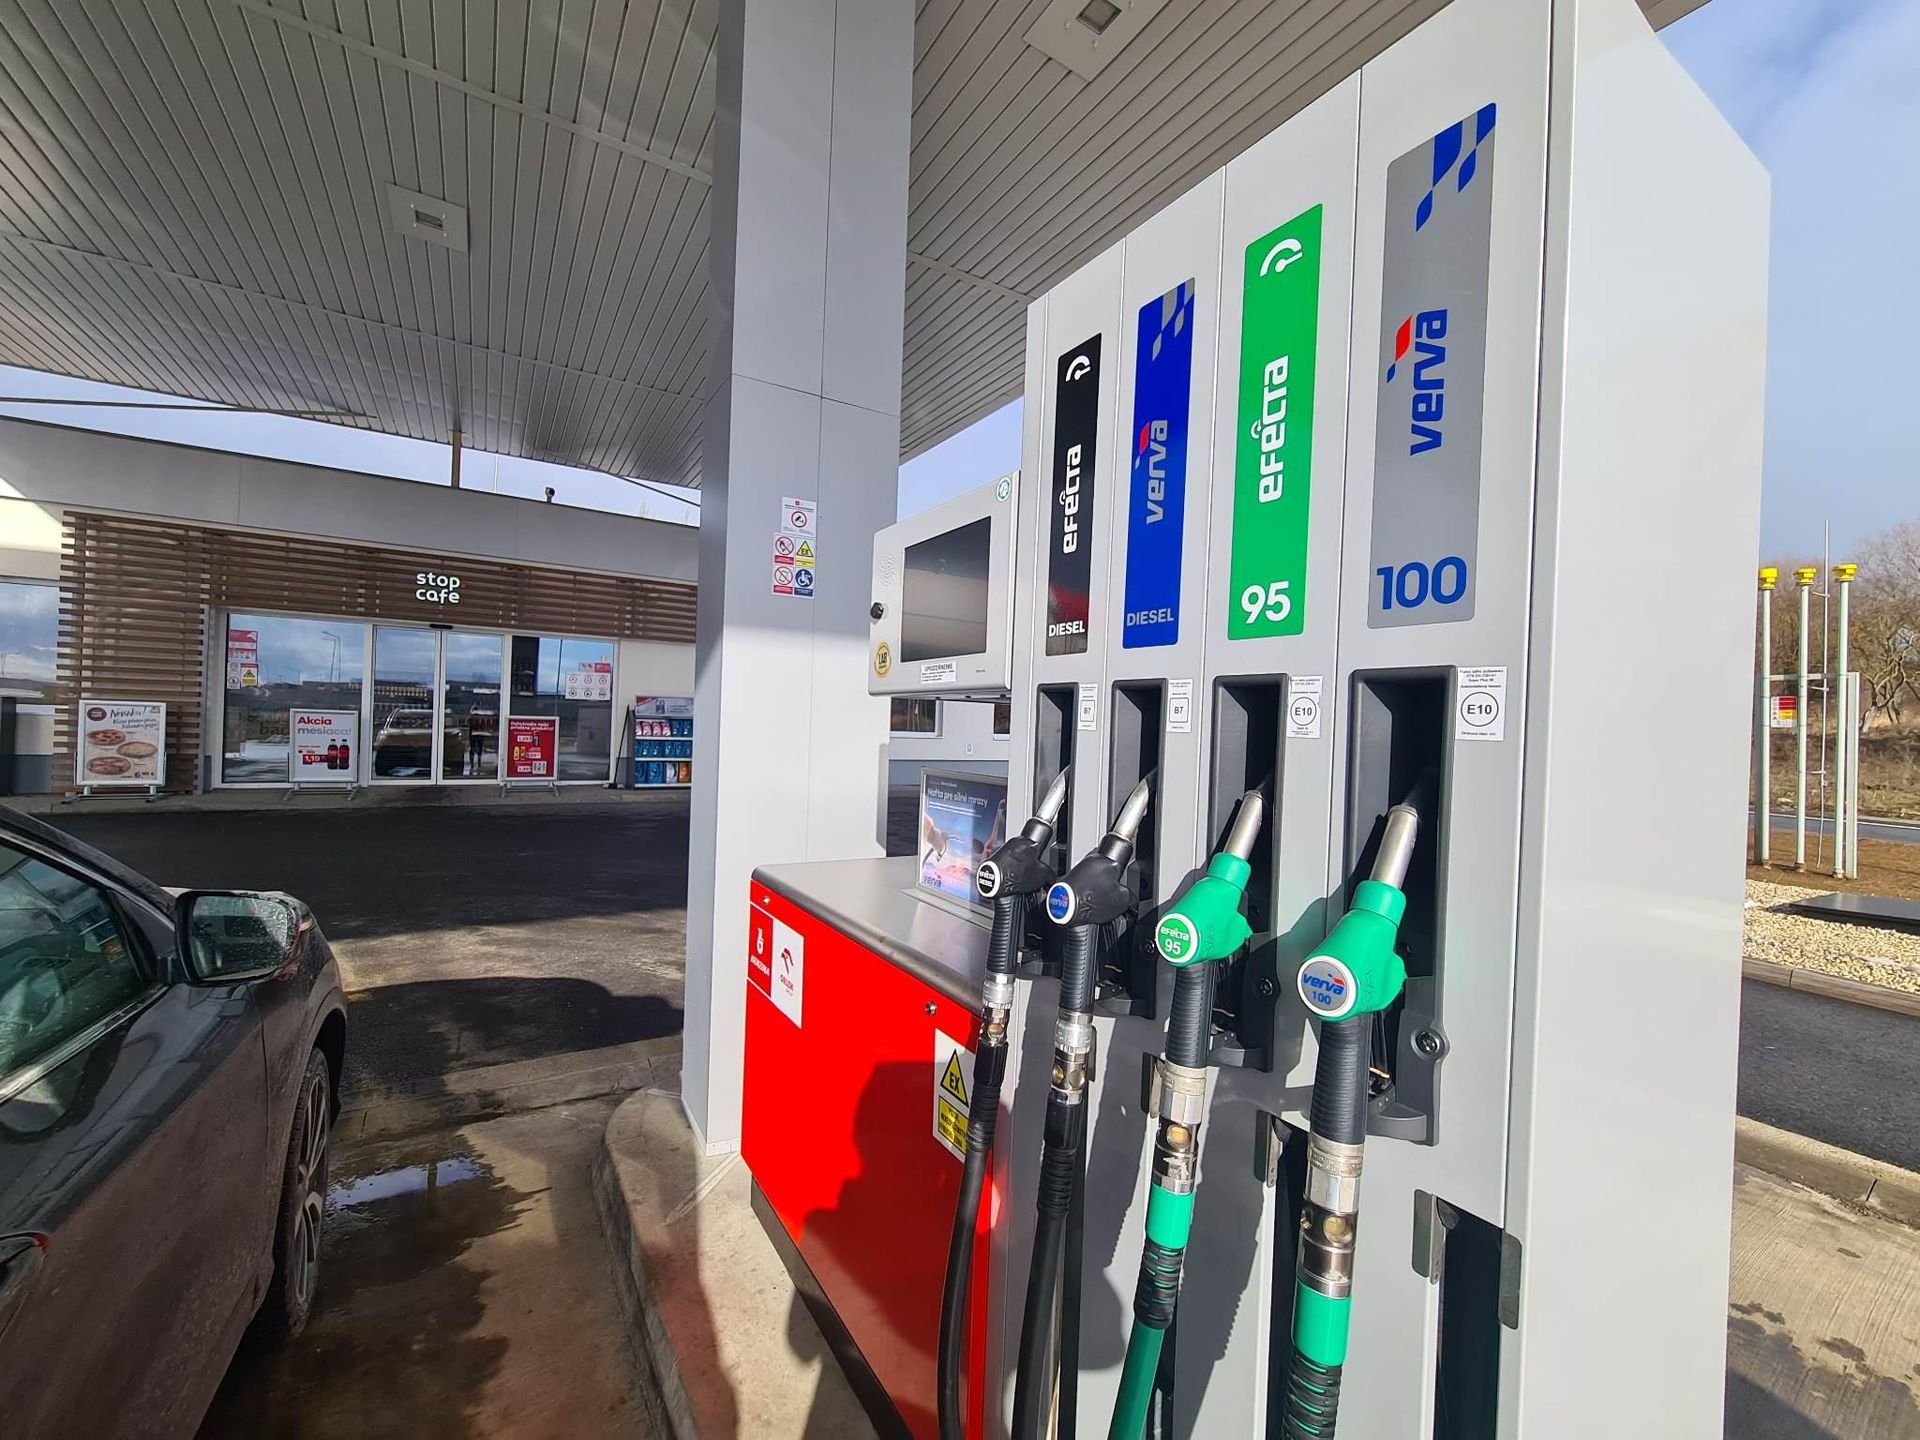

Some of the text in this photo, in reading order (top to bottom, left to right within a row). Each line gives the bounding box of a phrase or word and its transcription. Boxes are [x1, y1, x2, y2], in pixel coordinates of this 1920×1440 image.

[1409, 308, 1448, 457] verva
[1250, 355, 1289, 503] efecta
[1146, 420, 1168, 525] verva
[1059, 443, 1081, 554] efecta
[1376, 556, 1467, 610] 100
[415, 589, 460, 604] cafe
[1241, 580, 1291, 624] 95
[1126, 608, 1174, 627] DIESEL
[1048, 620, 1086, 637] DIESEL
[1174, 706, 1184, 715] B7
[1295, 707, 1312, 716] E10
[1467, 704, 1492, 715] E10
[297, 716, 332, 725] Akcia
[297, 727, 352, 735] mesiaca!
[927, 788, 943, 798] Nafta
[944, 792, 953, 800] pre
[968, 796, 988, 808] mrazy
[923, 875, 942, 887] verva
[1160, 926, 1190, 941] efecta
[1164, 939, 1181, 955] 95
[1303, 973, 1344, 996] verva
[1311, 990, 1332, 1005] 100
[949, 1071, 960, 1094] EX
